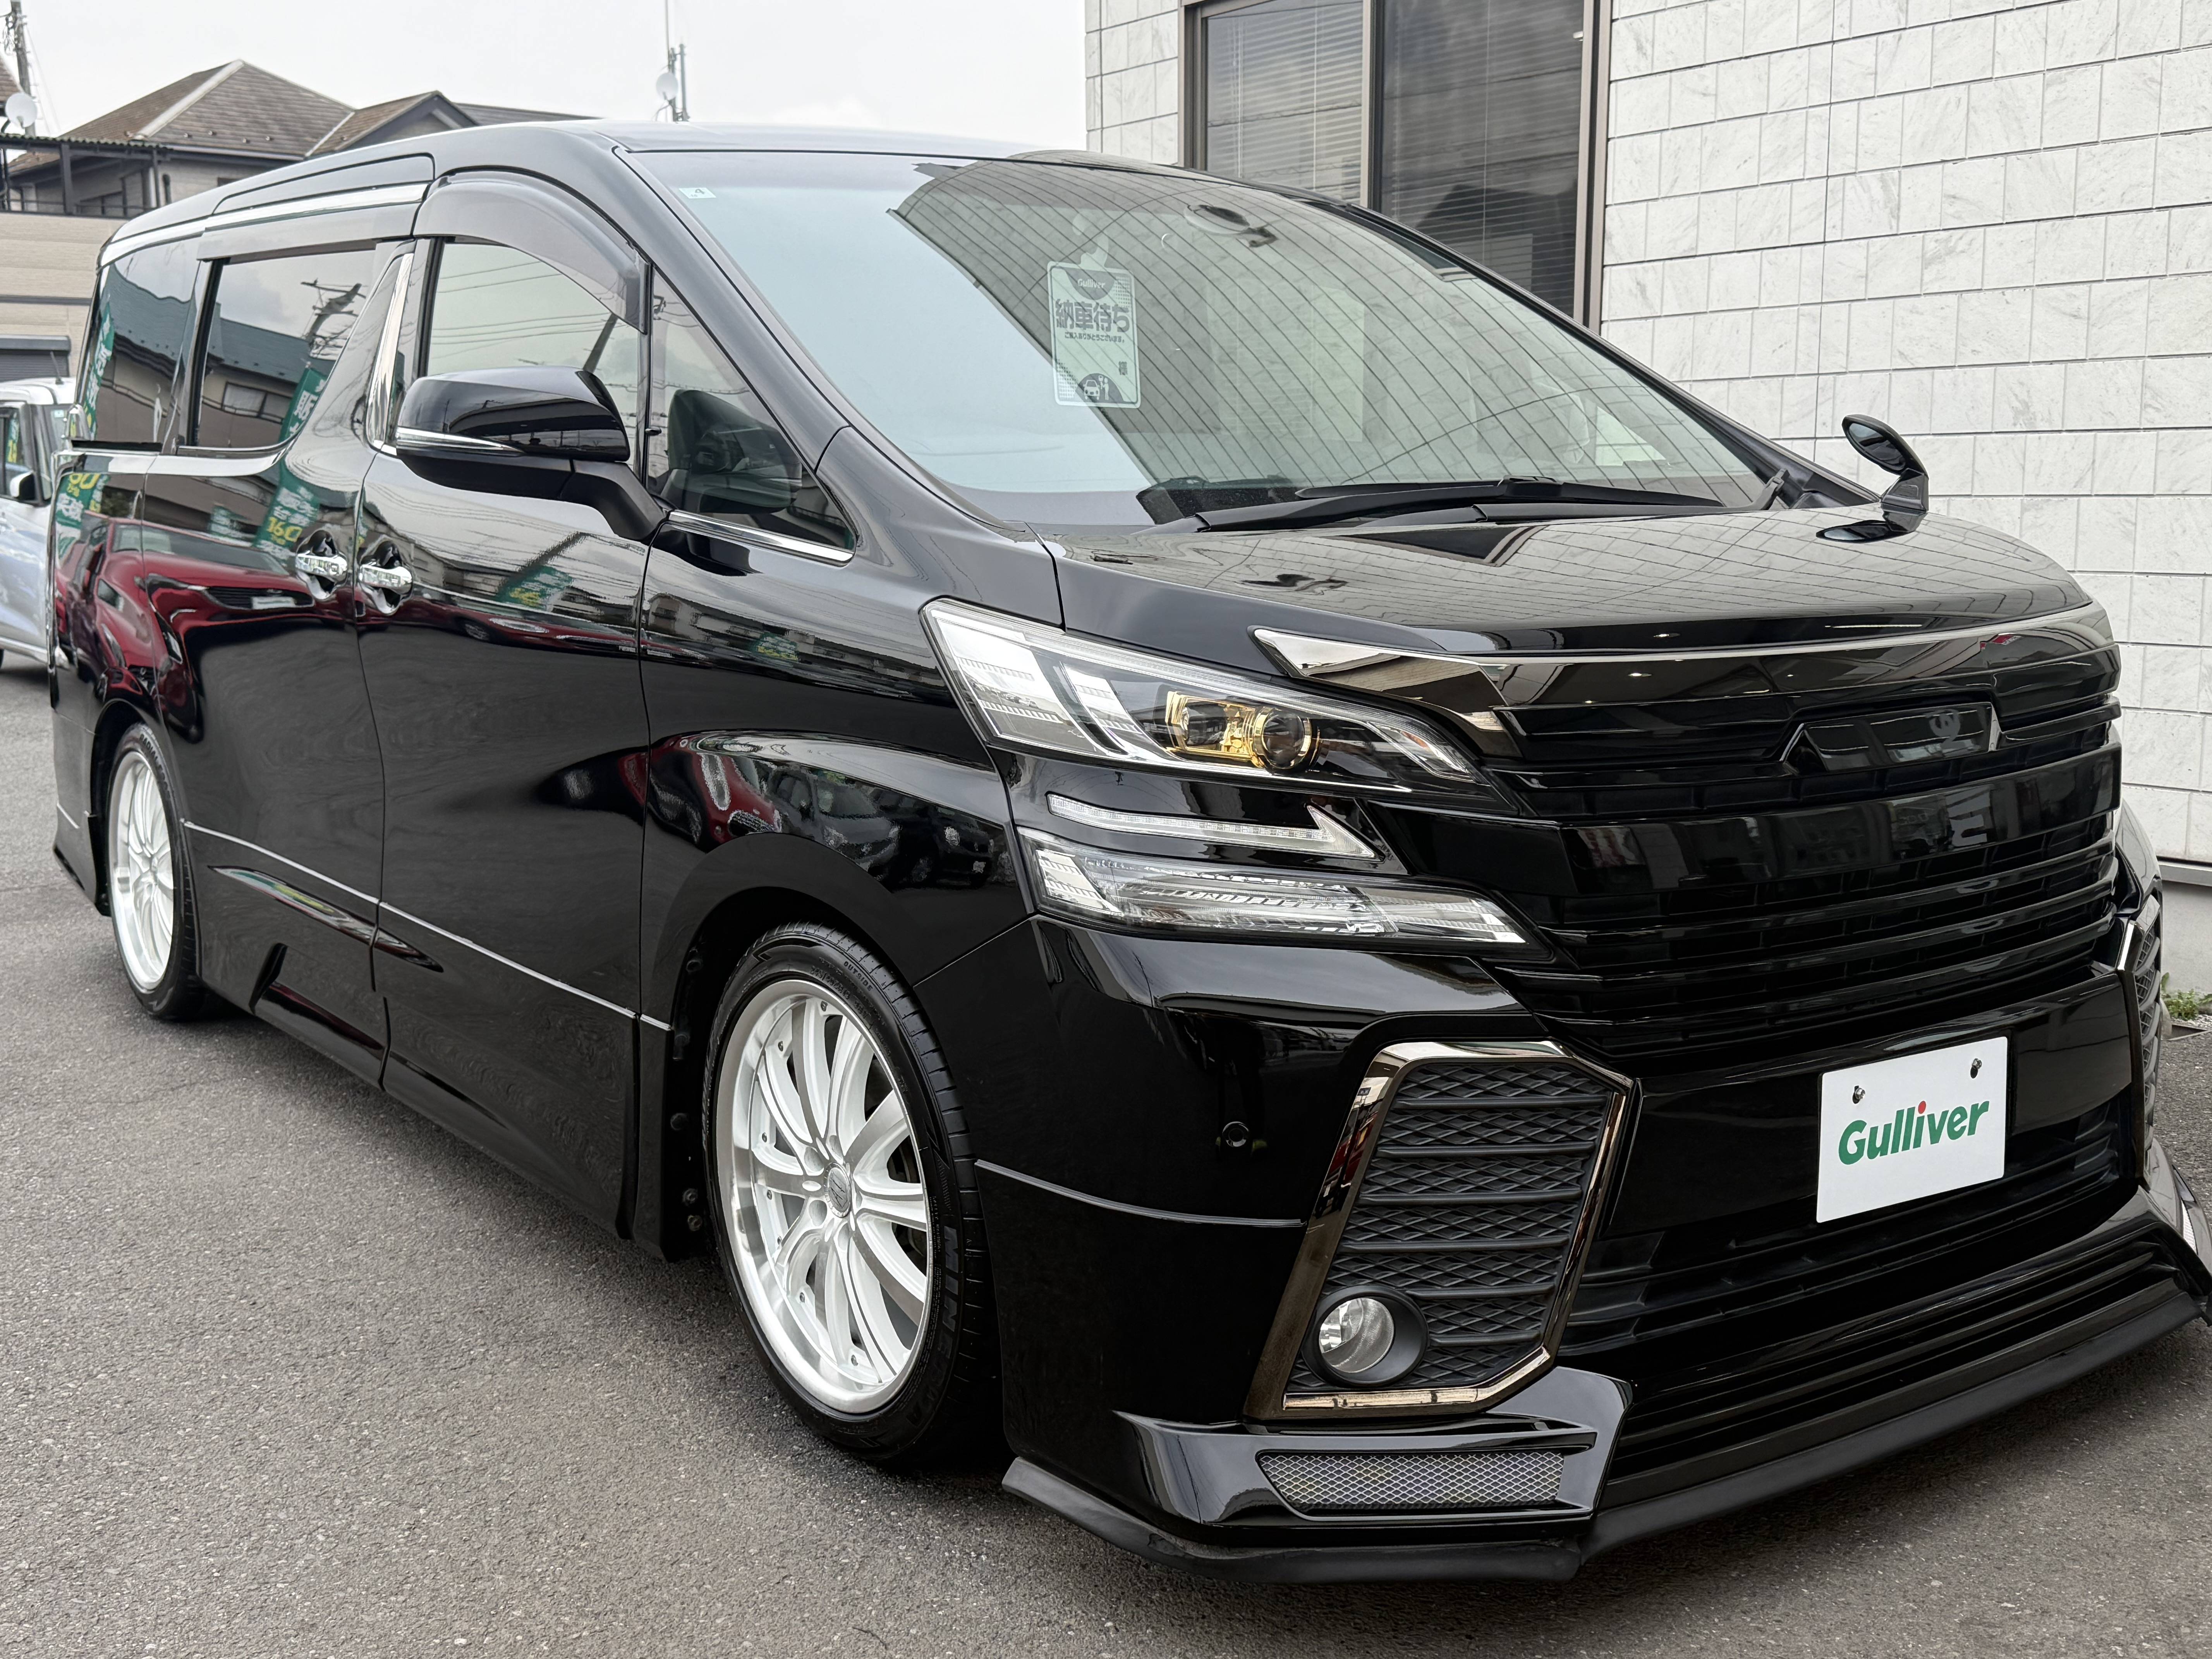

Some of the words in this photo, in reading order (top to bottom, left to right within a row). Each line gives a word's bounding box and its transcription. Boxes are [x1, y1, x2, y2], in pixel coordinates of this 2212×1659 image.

[1078, 279, 1105, 288] Gulliver
[1056, 299, 1130, 332] 納車待ち
[844, 961, 873, 991] OUTSIDE
[1838, 1101, 1989, 1165] Gulliver
